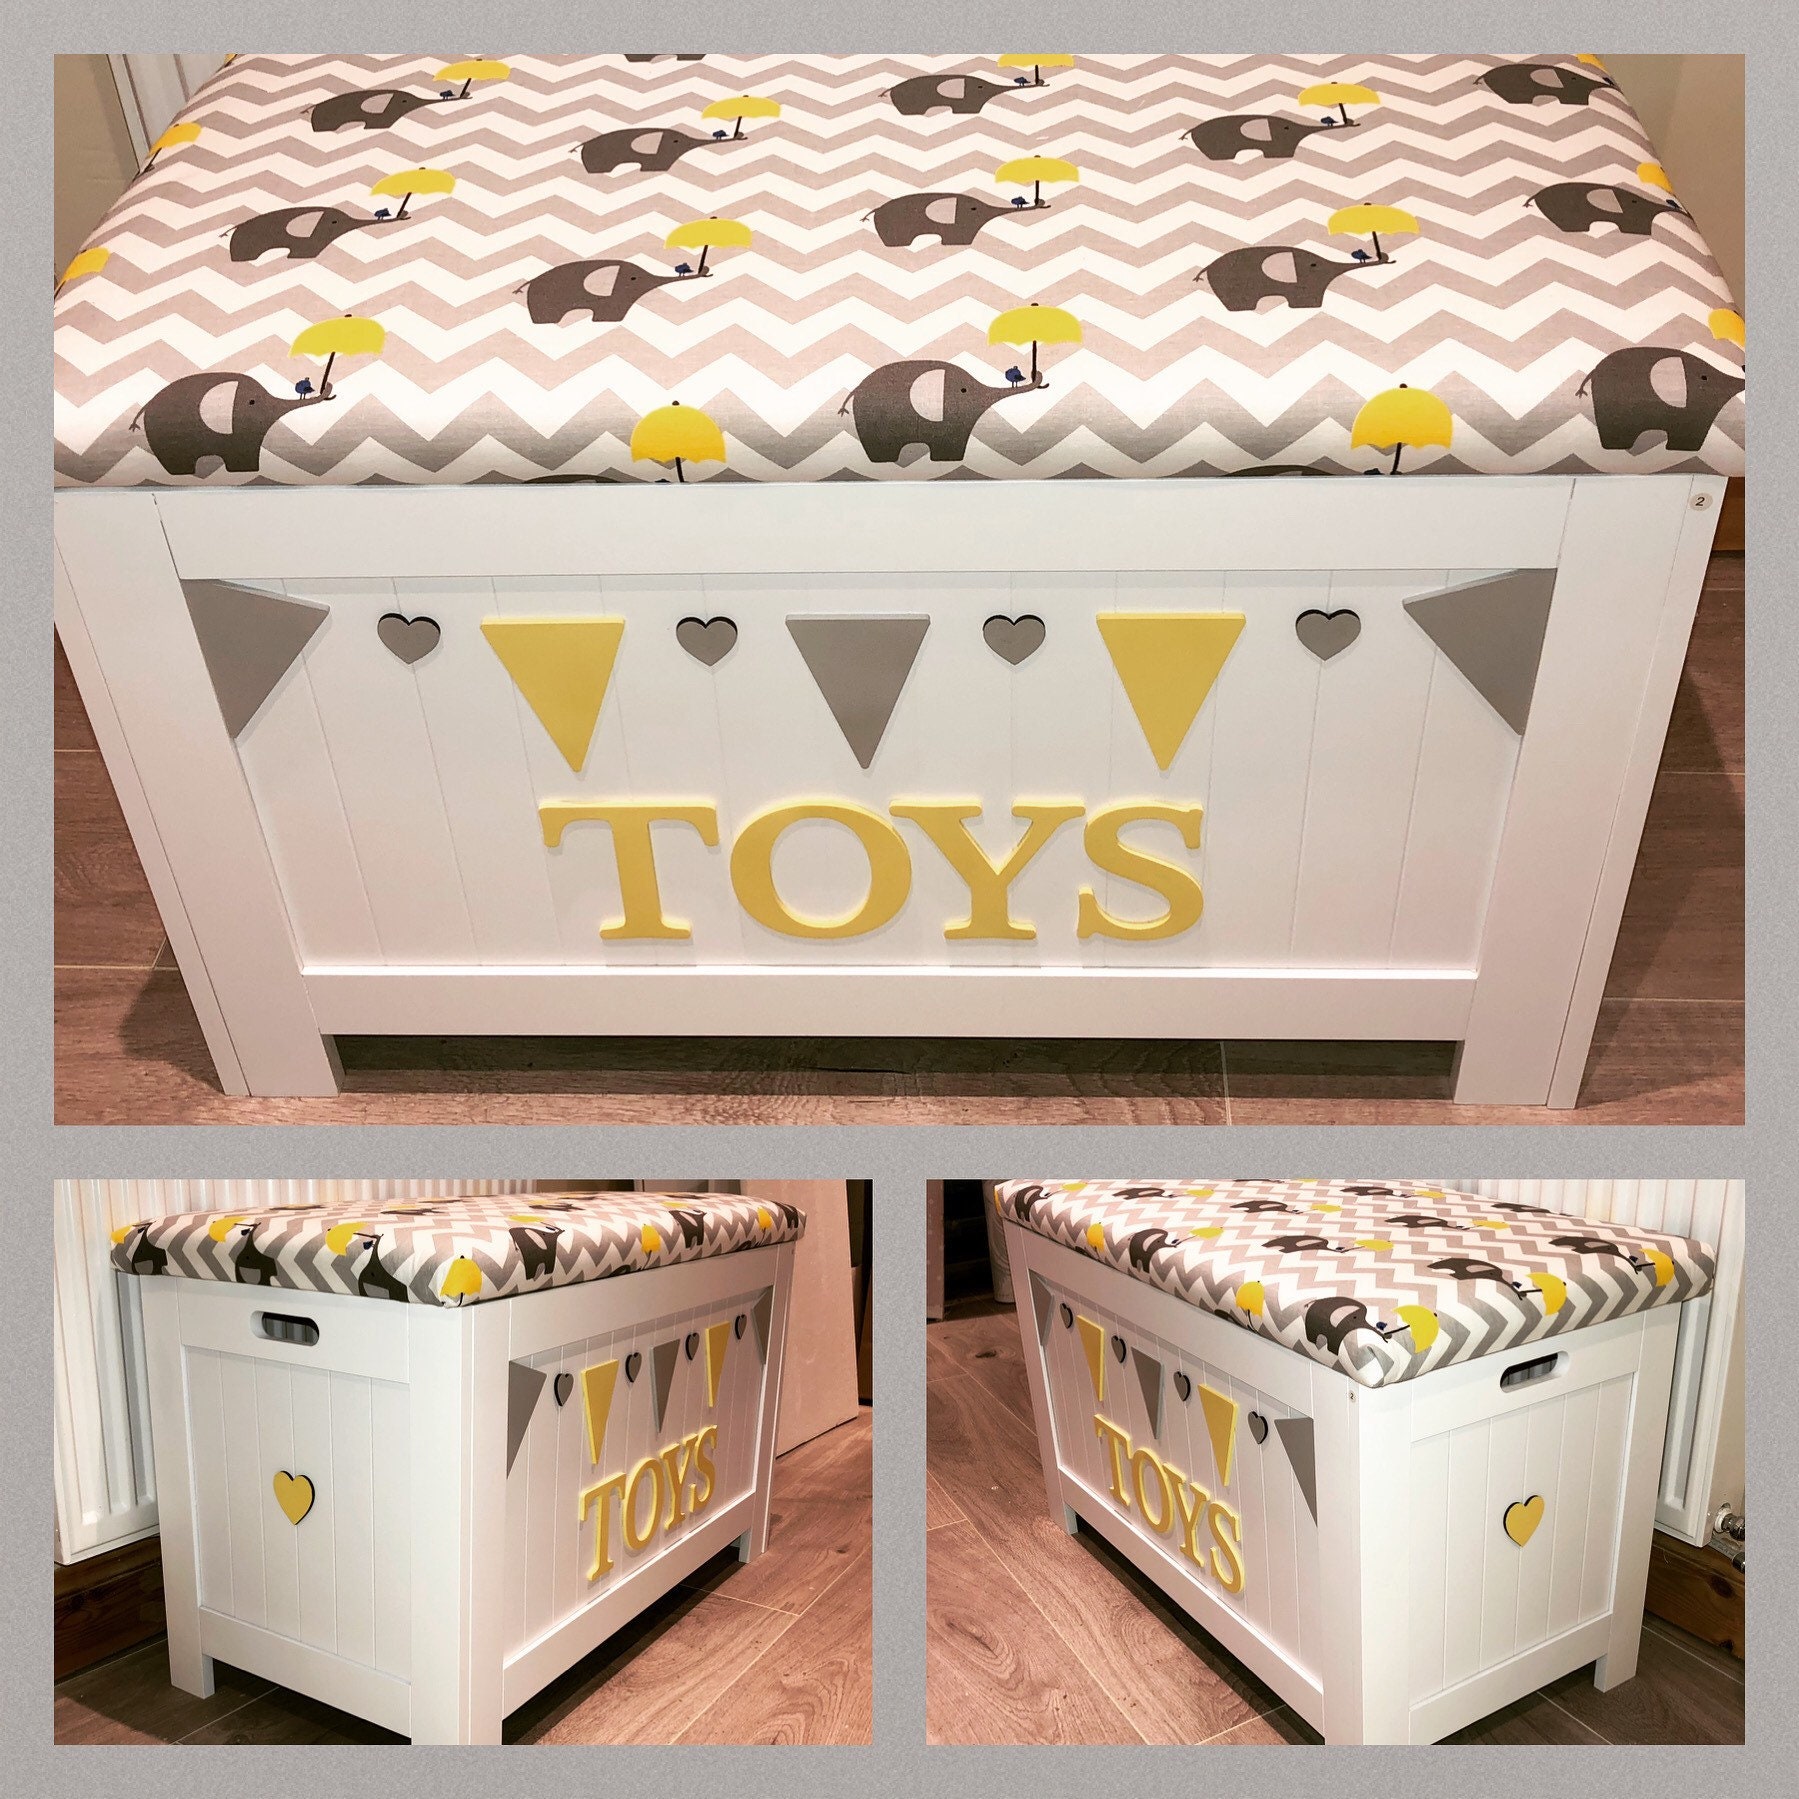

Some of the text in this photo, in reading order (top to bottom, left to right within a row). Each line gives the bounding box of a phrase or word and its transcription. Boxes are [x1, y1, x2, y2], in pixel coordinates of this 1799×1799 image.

[1695, 496, 1706, 507] 2
[538, 798, 1204, 941] TOYS
[578, 1424, 718, 1582] TOYS
[1093, 1413, 1245, 1595] TOYS
